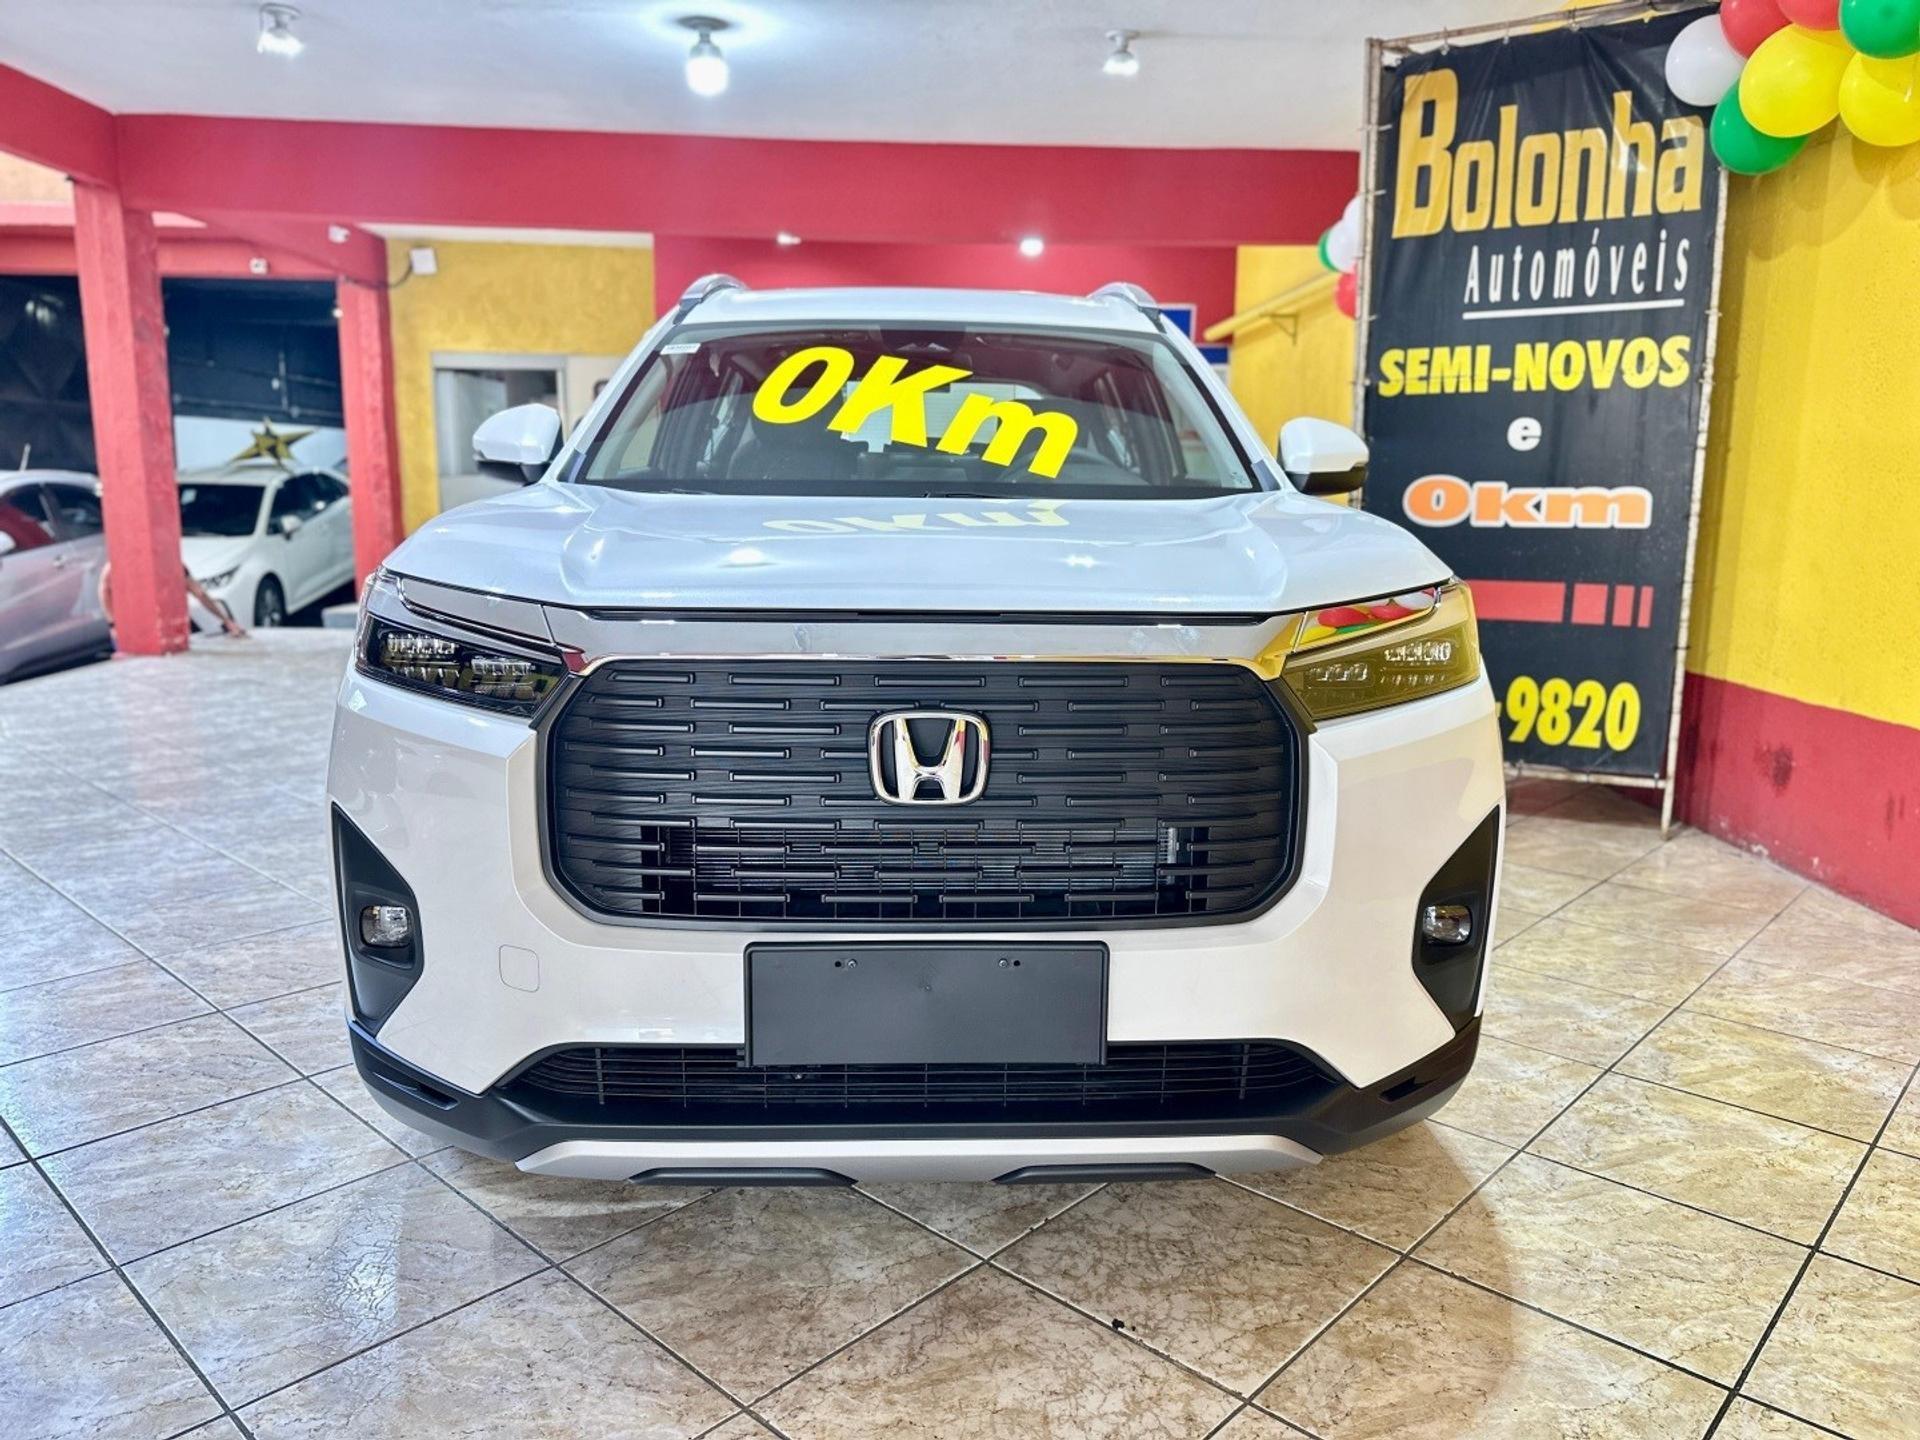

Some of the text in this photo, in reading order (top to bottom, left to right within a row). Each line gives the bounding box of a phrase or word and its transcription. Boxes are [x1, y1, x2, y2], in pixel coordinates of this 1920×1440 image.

[1391, 68, 1705, 239] Bolonha
[1463, 227, 1691, 305] Automóveis
[1378, 336, 1691, 398] SEMI-NOVOS
[1507, 416, 1542, 451] e
